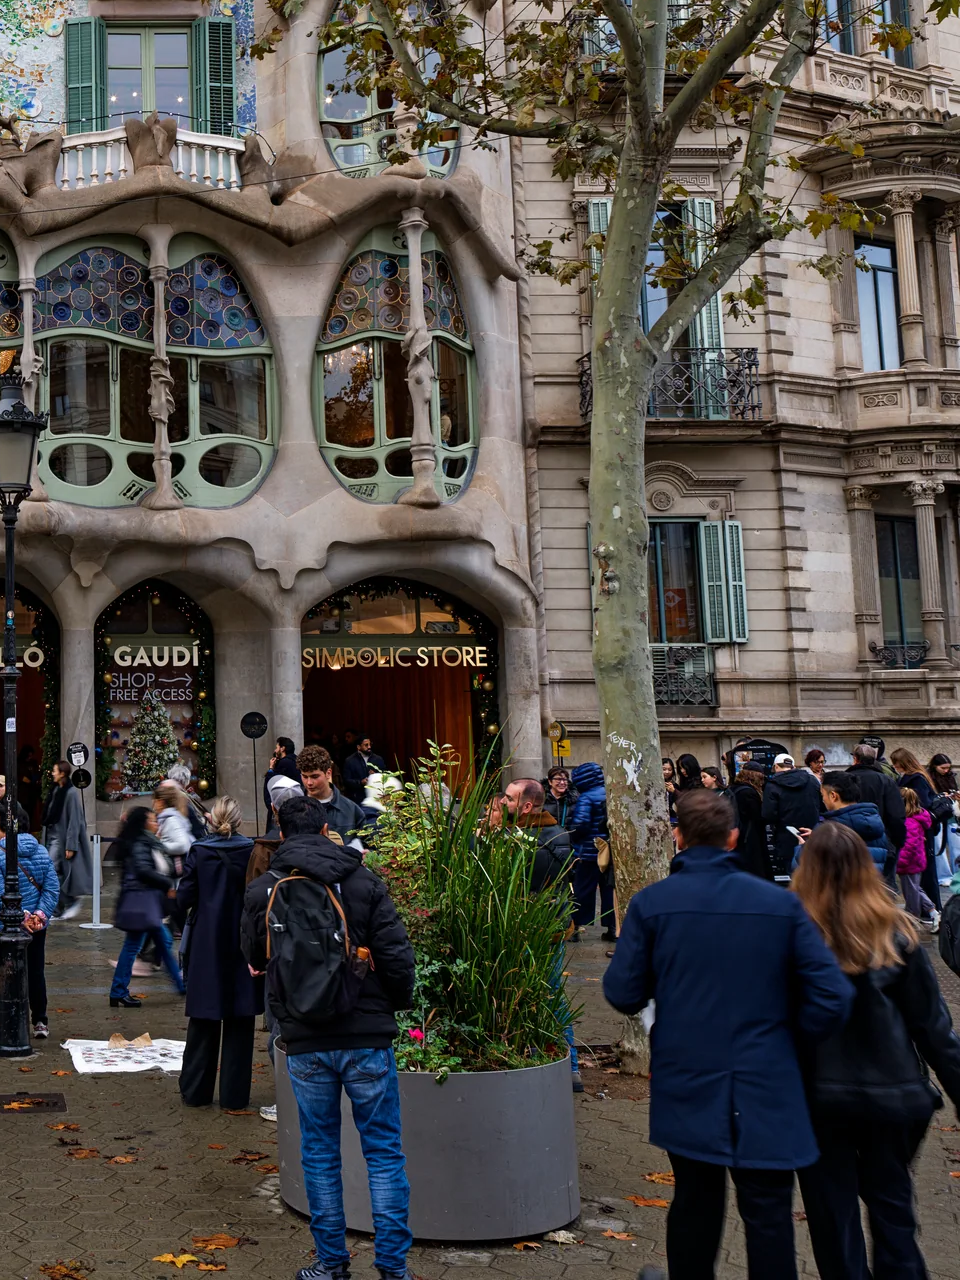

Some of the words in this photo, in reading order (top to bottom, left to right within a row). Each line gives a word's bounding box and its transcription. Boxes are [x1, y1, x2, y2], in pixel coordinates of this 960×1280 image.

[114, 640, 200, 667] GAUDÍ
[301, 646, 412, 668] SIMBOLIC
[416, 646, 488, 667] STORE
[109, 672, 156, 688] SHOP
[109, 688, 139, 701] FREE
[142, 688, 193, 701] ACCESS
